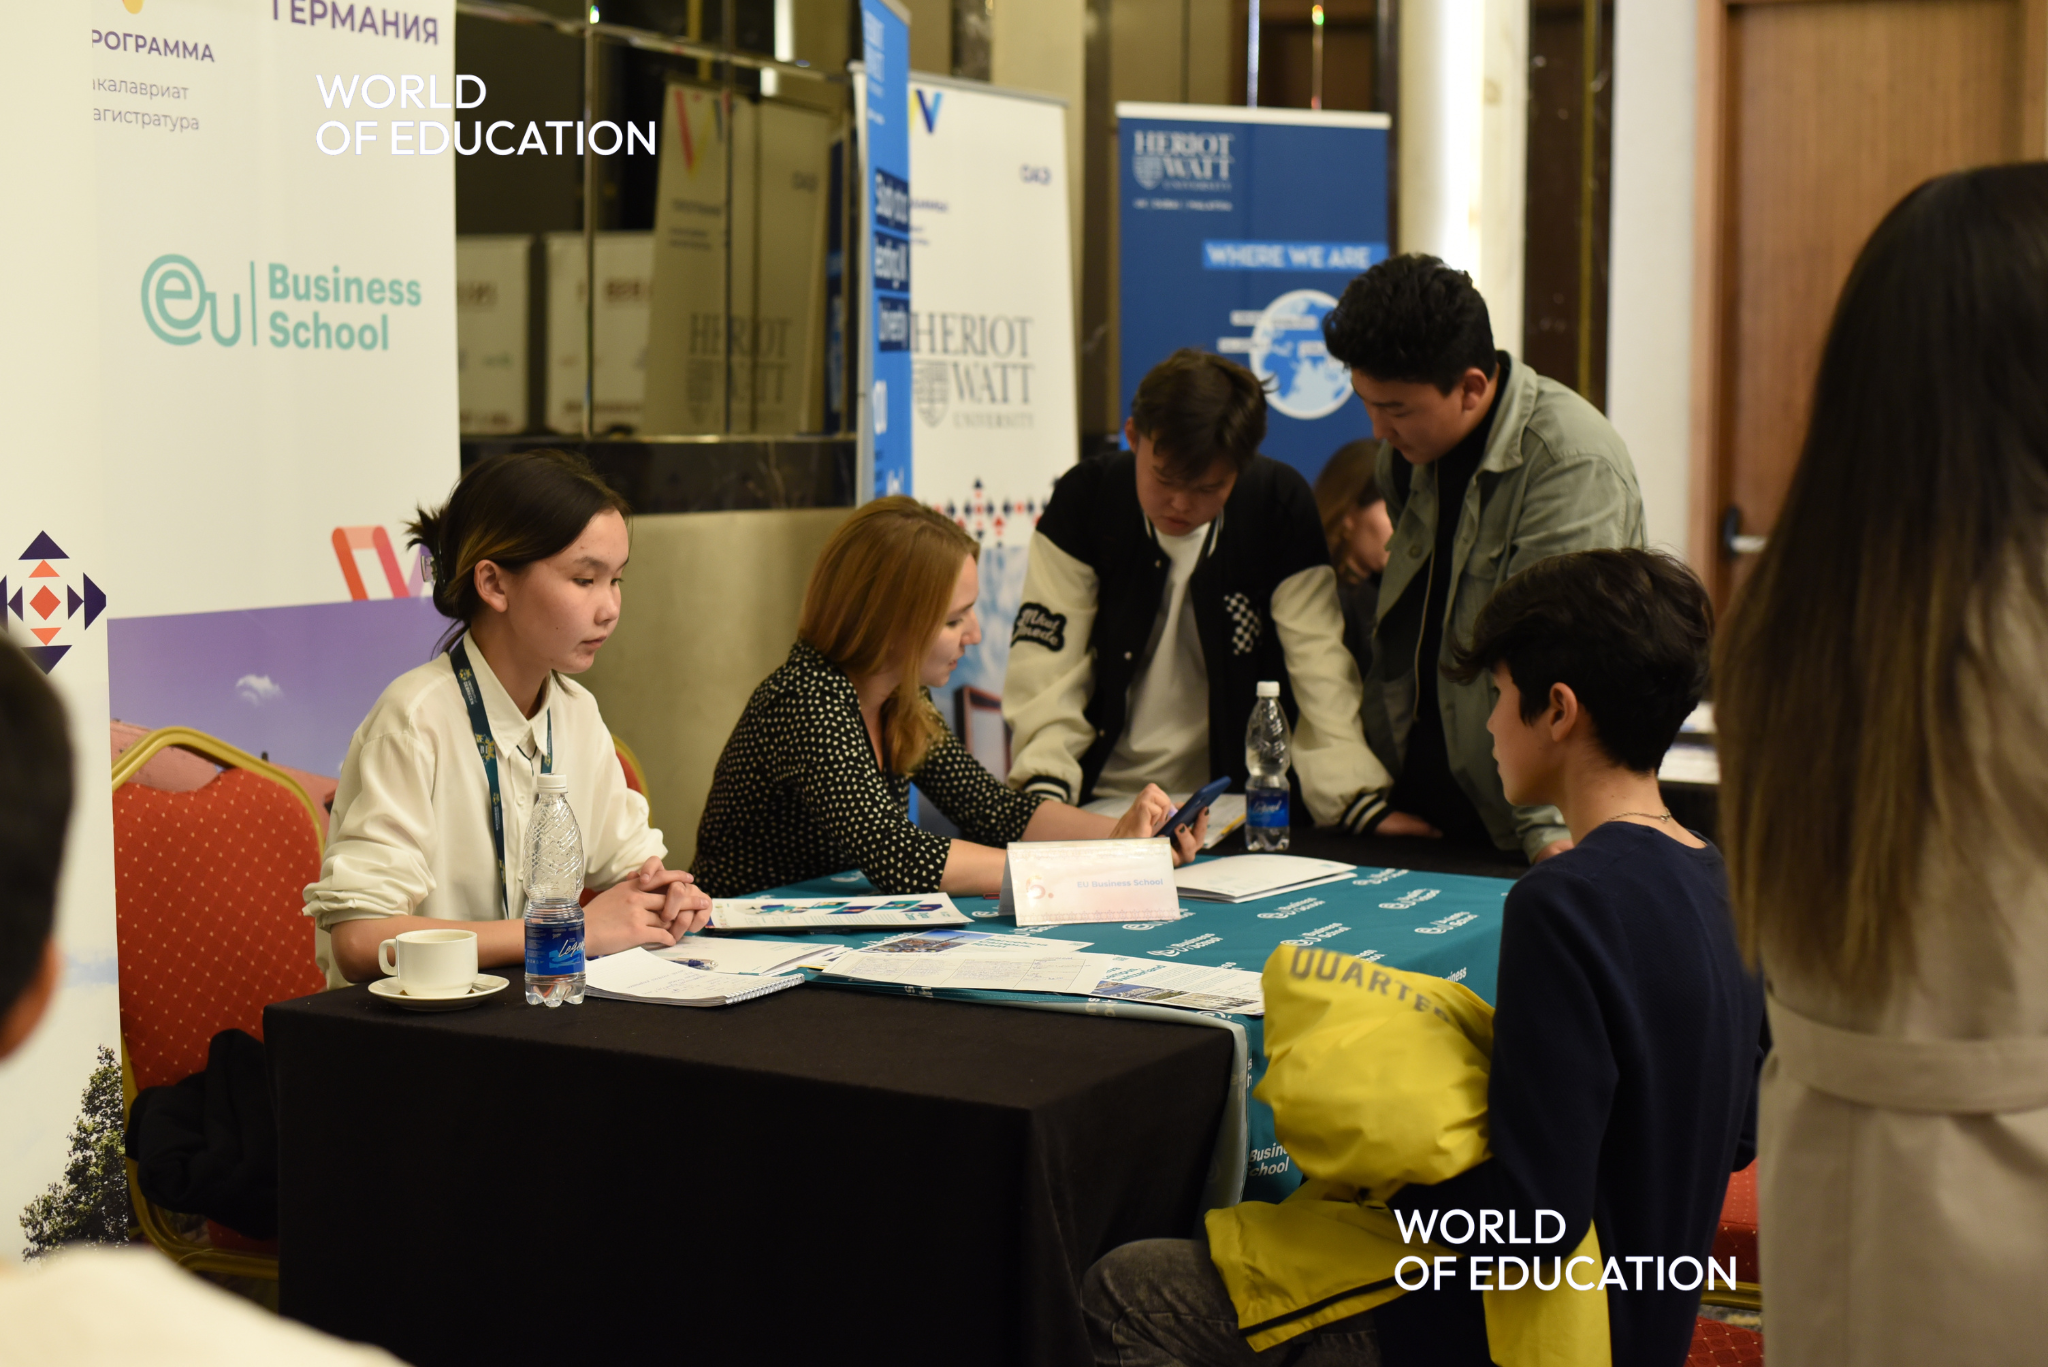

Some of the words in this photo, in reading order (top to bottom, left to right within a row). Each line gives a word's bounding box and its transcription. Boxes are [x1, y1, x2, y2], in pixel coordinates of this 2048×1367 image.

[1134, 130, 1235, 156] HERIOT
[1162, 156, 1235, 181] WATT
[1206, 243, 1284, 268] WHERE
[1288, 245, 1323, 269] WE
[1327, 246, 1371, 270] ARE
[268, 263, 422, 307] Business
[269, 310, 389, 351] School
[910, 312, 1035, 358] HERIOT
[952, 361, 1036, 404] WATT
[1092, 879, 1131, 888] Business
[1133, 878, 1164, 886] School
[1248, 1156, 1290, 1177] chool
